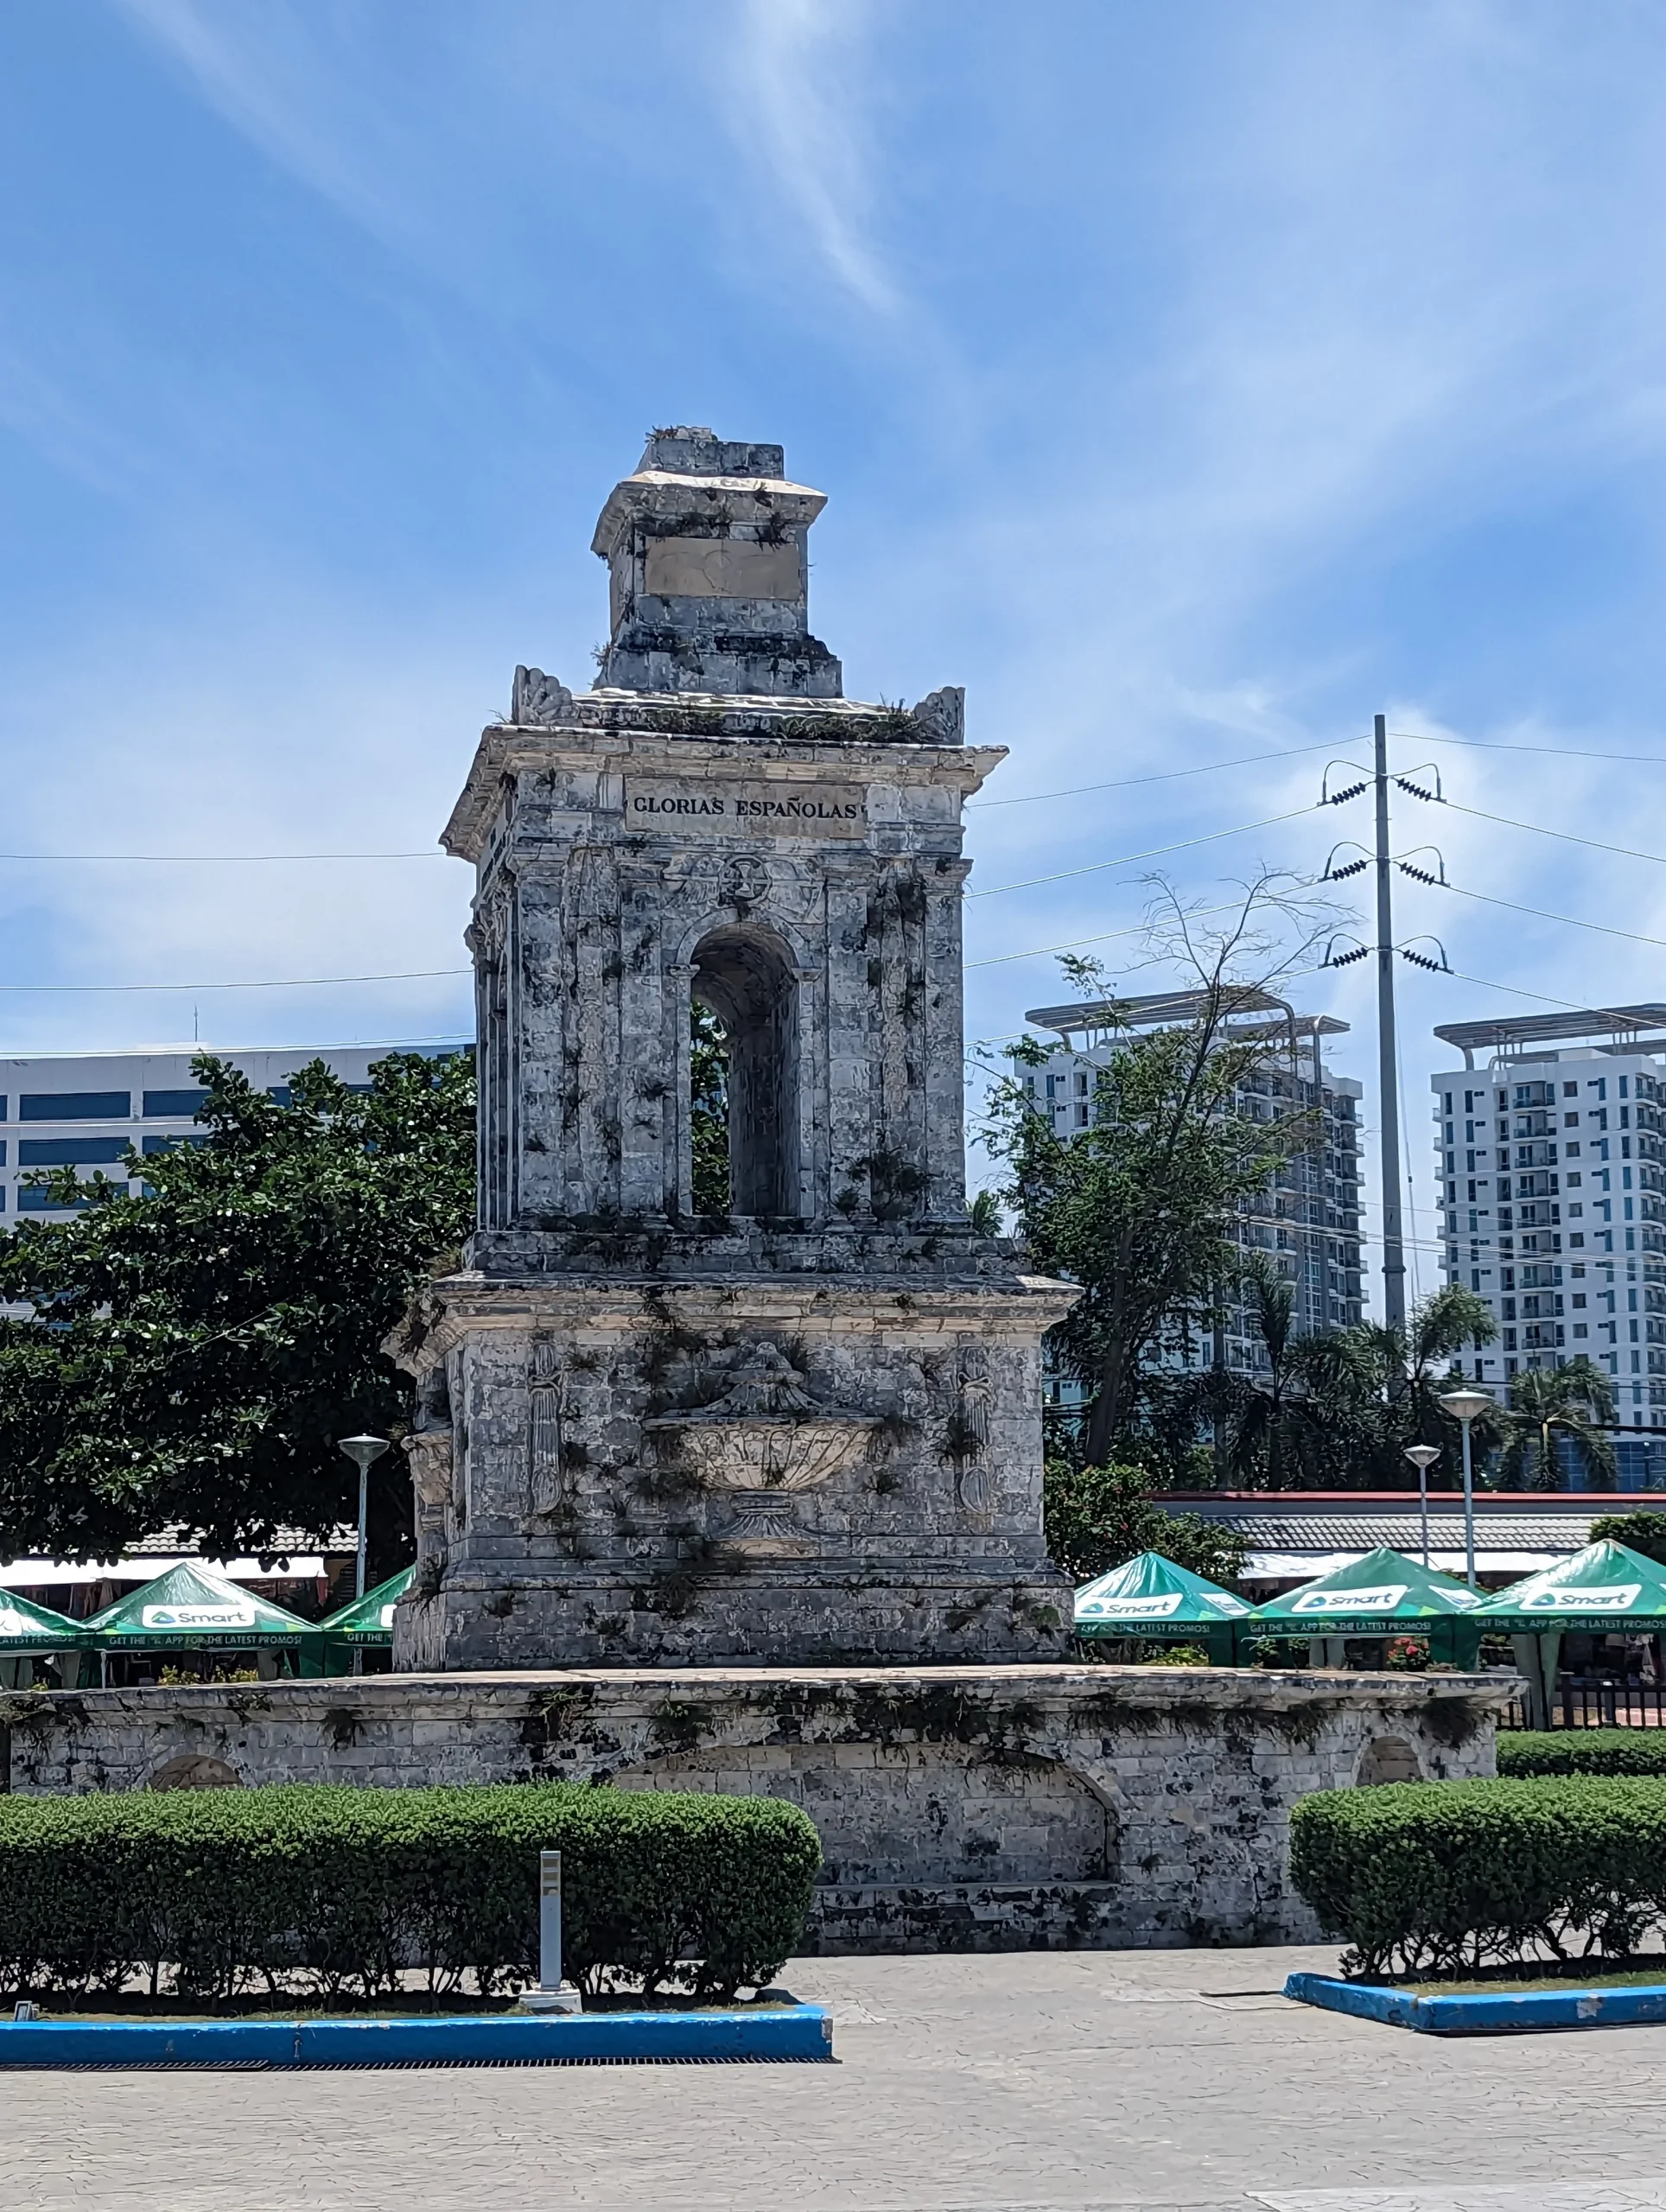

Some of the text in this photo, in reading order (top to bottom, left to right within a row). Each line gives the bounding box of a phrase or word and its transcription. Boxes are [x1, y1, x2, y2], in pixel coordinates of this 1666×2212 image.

[633, 797, 857, 818] GLORIAS ESPAÑOLAS
[1328, 1592, 1393, 1605] Smart
[1558, 1592, 1628, 1605] Smart
[1106, 1601, 1171, 1614] Smart
[178, 1611, 247, 1624] Smart
[225, 1636, 257, 1644] LATEST
